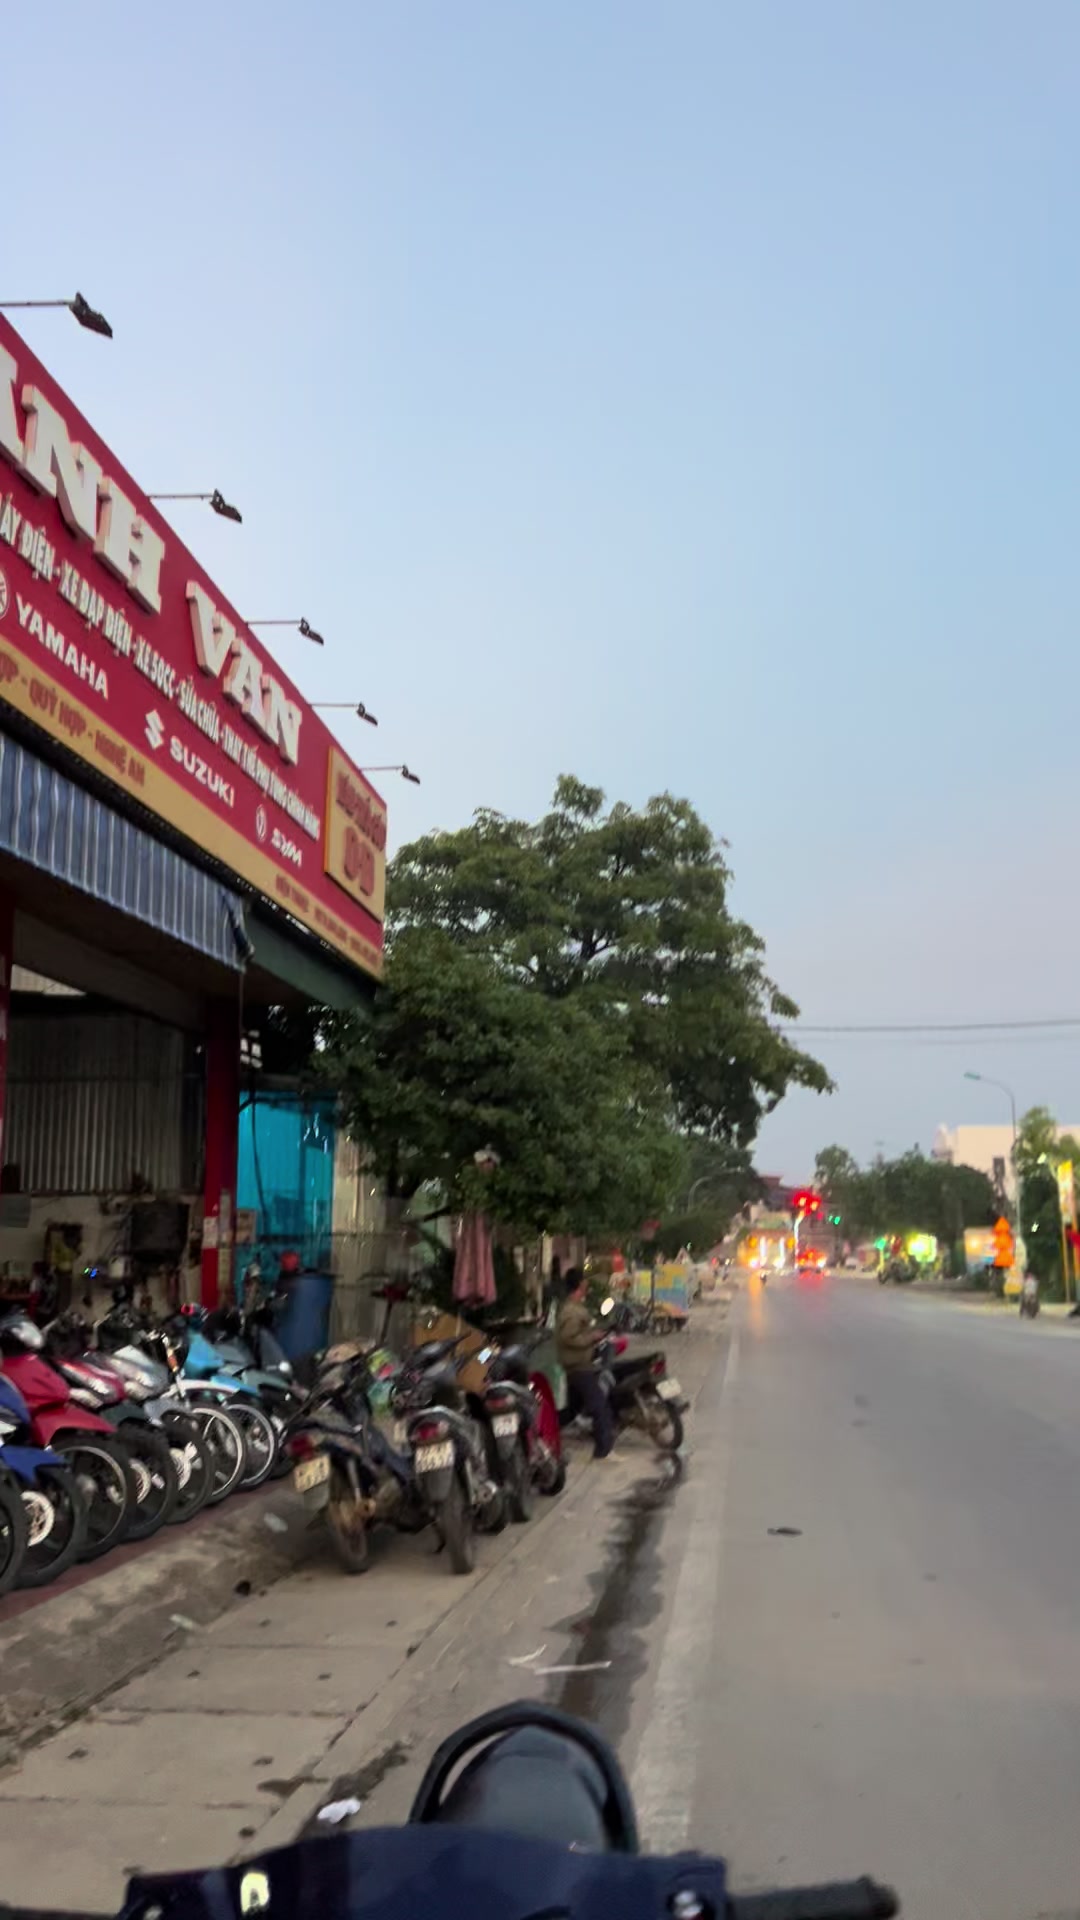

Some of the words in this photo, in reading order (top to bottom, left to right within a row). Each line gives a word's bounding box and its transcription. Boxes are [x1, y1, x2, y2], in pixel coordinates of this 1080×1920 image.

[0, 492, 21, 546] ÁY
[18, 525, 55, 581] ĐIỆN
[59, 557, 80, 607] XE
[80, 576, 104, 630] ĐẠP
[103, 603, 132, 657] ĐIỆN
[134, 634, 152, 676] XE
[150, 649, 176, 699] 50CC
[186, 580, 302, 766] VAN
[16, 591, 108, 701] YAMAHA
[170, 735, 235, 809] SUZUKI
[271, 828, 303, 867] SYM
